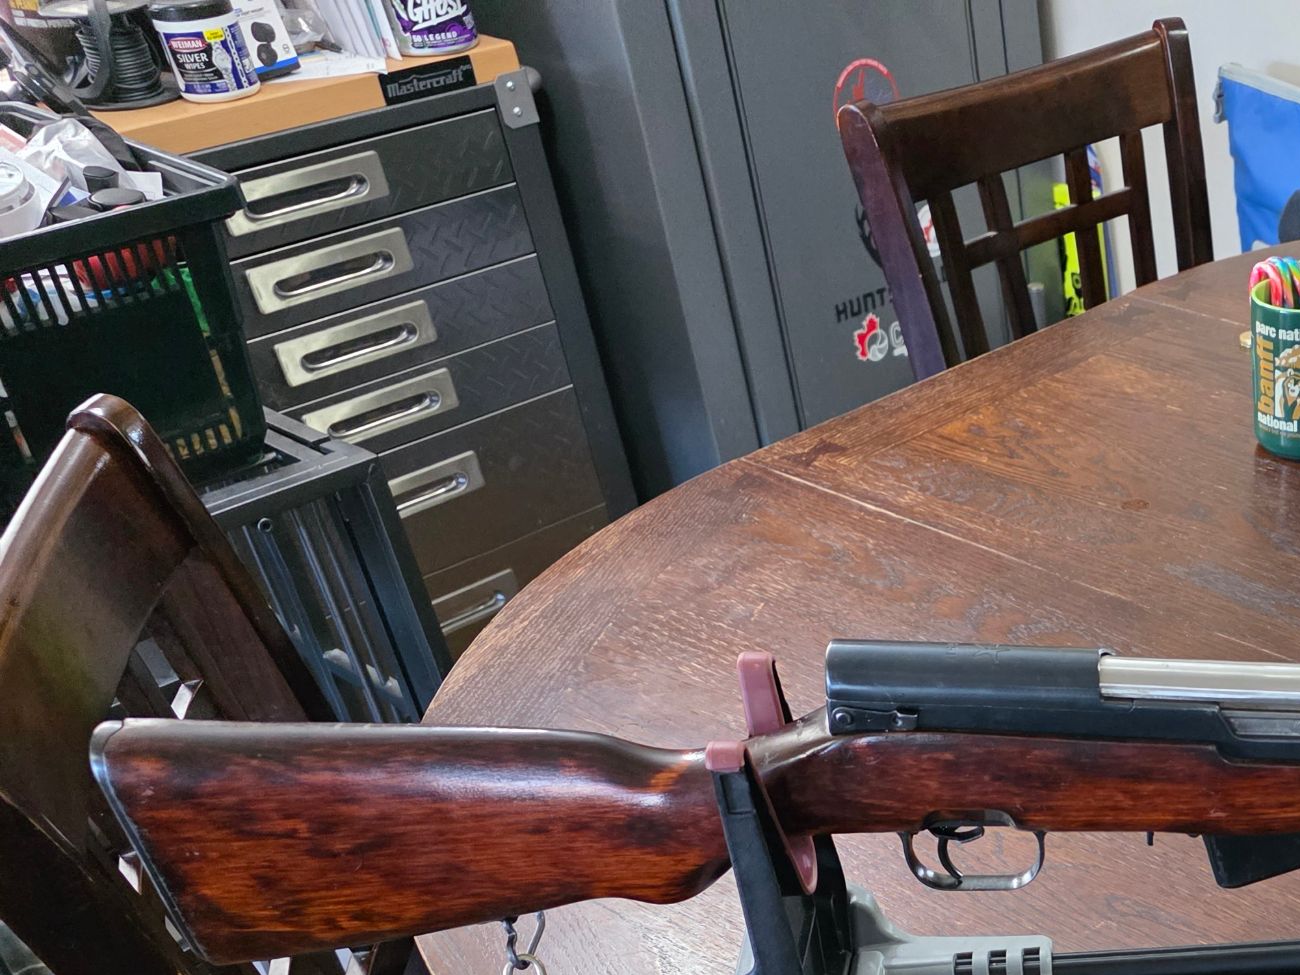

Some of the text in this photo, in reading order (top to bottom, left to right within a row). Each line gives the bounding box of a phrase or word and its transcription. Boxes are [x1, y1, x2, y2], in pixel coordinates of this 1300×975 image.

[424, 31, 458, 41] LEGEND
[170, 40, 203, 49] WEIMAN
[176, 52, 209, 63] SILVER
[184, 62, 206, 70] WIPES
[386, 68, 464, 98] Mastercraft
[835, 287, 893, 323] HUNT
[1256, 335, 1274, 417] banff
[1257, 411, 1298, 433] national
